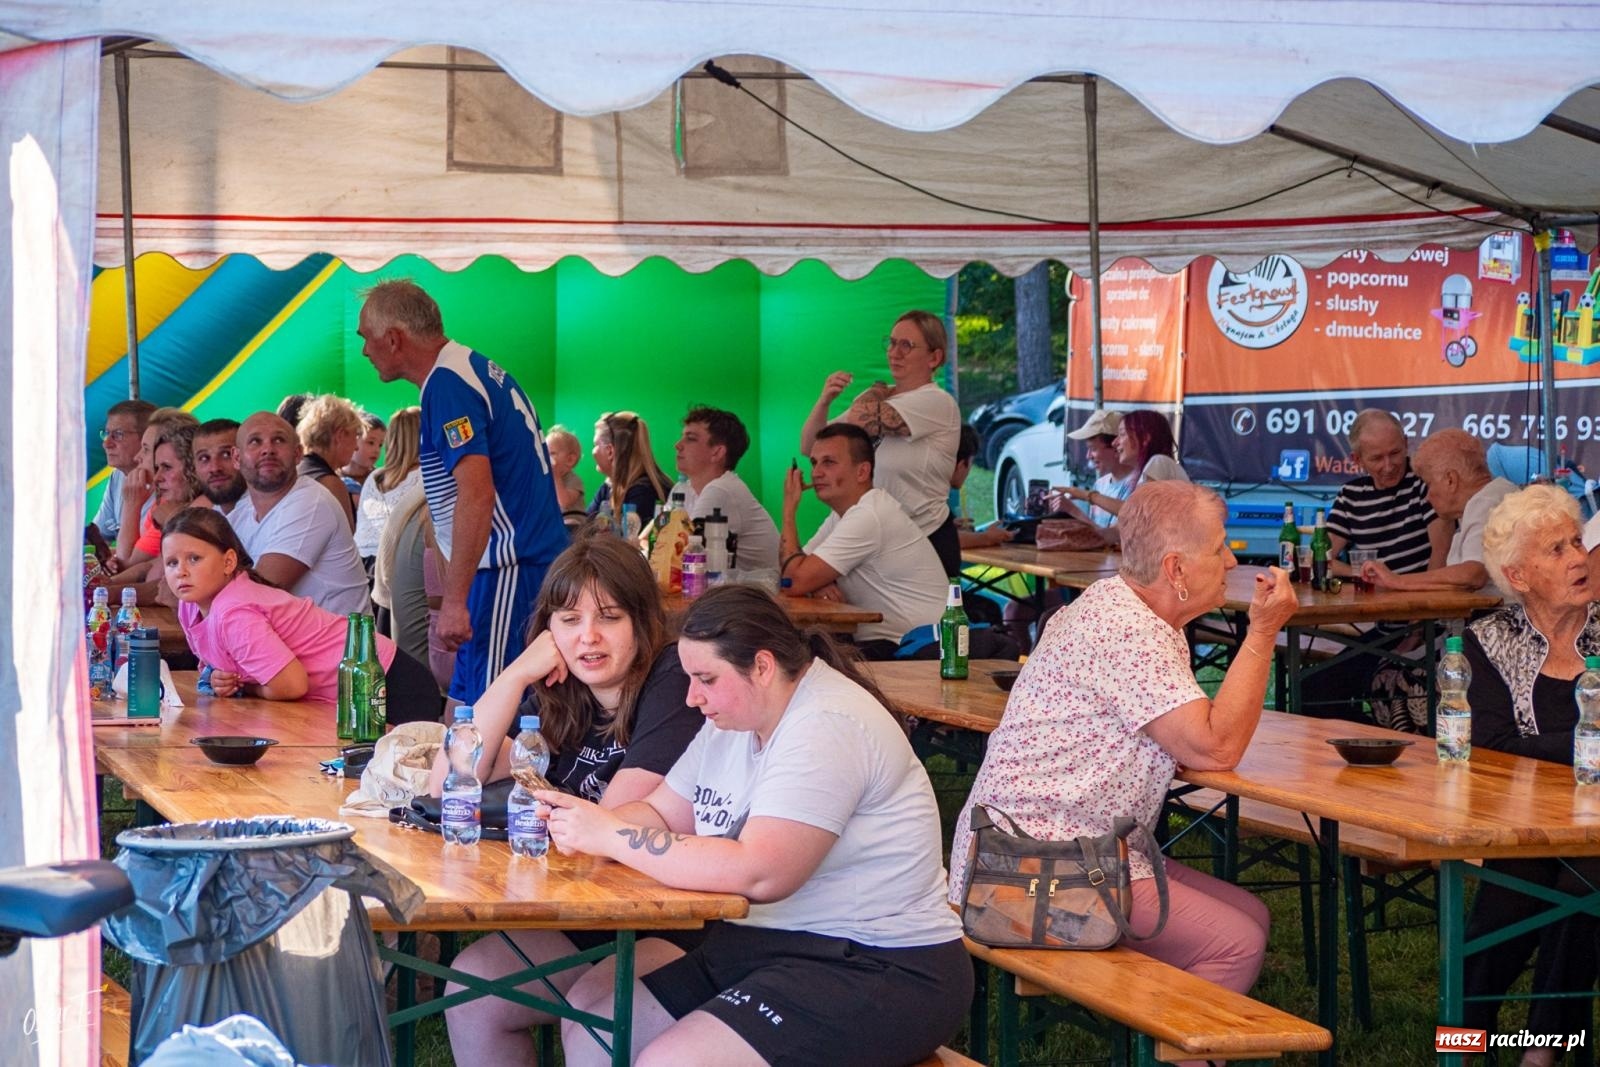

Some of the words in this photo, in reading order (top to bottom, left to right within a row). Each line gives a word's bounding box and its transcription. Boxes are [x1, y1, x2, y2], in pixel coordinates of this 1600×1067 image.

[1342, 248, 1368, 263] aty
[1327, 271, 1409, 289] popcornu
[1326, 294, 1379, 316] slushy
[1325, 320, 1422, 340] dmuchańce
[1266, 407, 1315, 435] 691
[1462, 413, 1511, 440] 665
[758, 1003, 783, 1025] VIE
